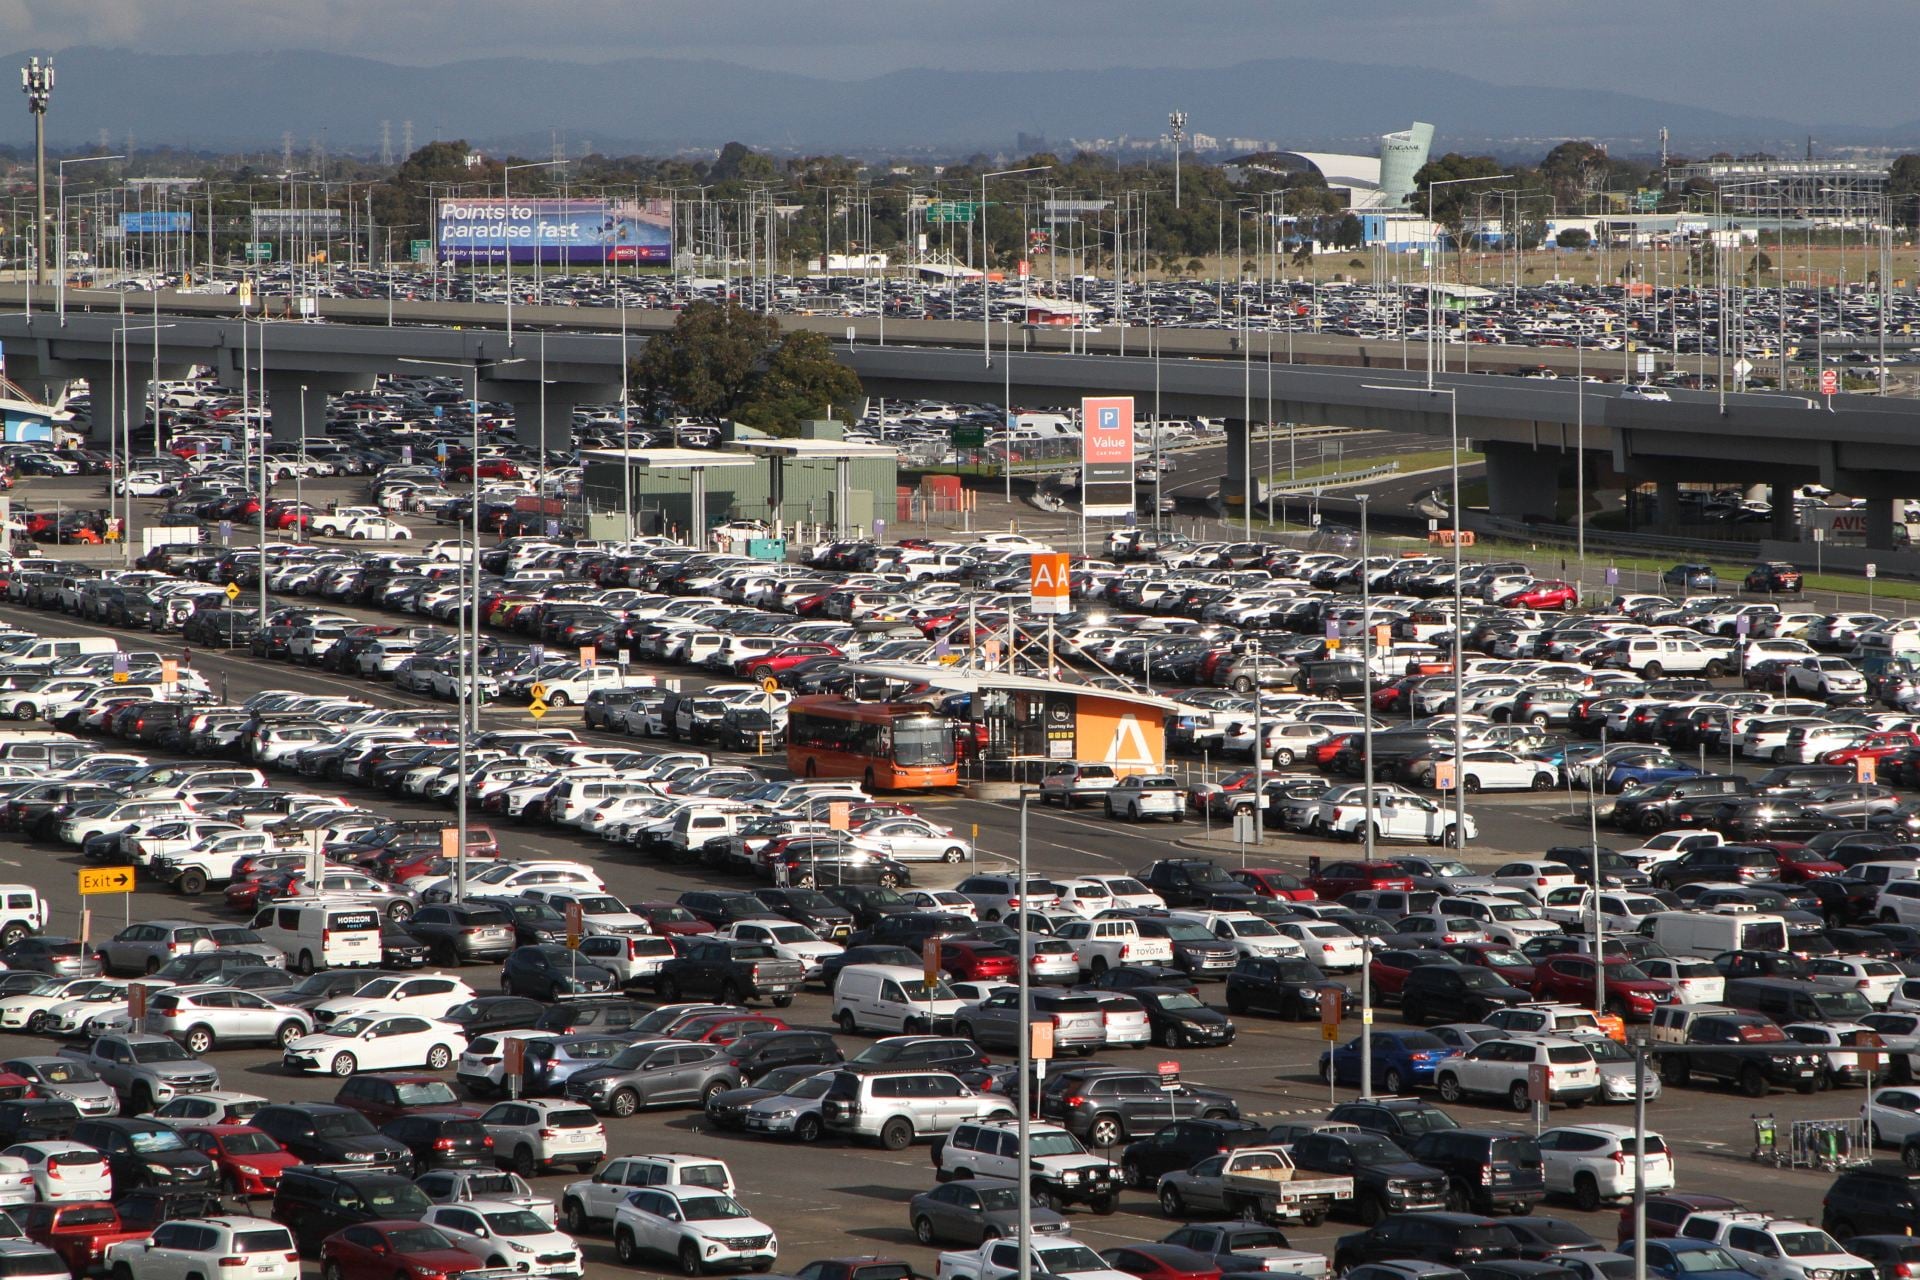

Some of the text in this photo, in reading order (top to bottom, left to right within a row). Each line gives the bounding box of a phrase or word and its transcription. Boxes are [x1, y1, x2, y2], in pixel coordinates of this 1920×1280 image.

[441, 203, 532, 220] Points to
[442, 221, 579, 241] paradise fast
[1103, 411, 1114, 425] P
[1093, 436, 1126, 448] Value
[1033, 563, 1055, 588] A
[1056, 563, 1069, 588] A
[1104, 713, 1159, 775] A
[84, 875, 111, 890] Exit
[337, 915, 371, 924] HORIZON
[1136, 948, 1164, 956] TOYOTA
